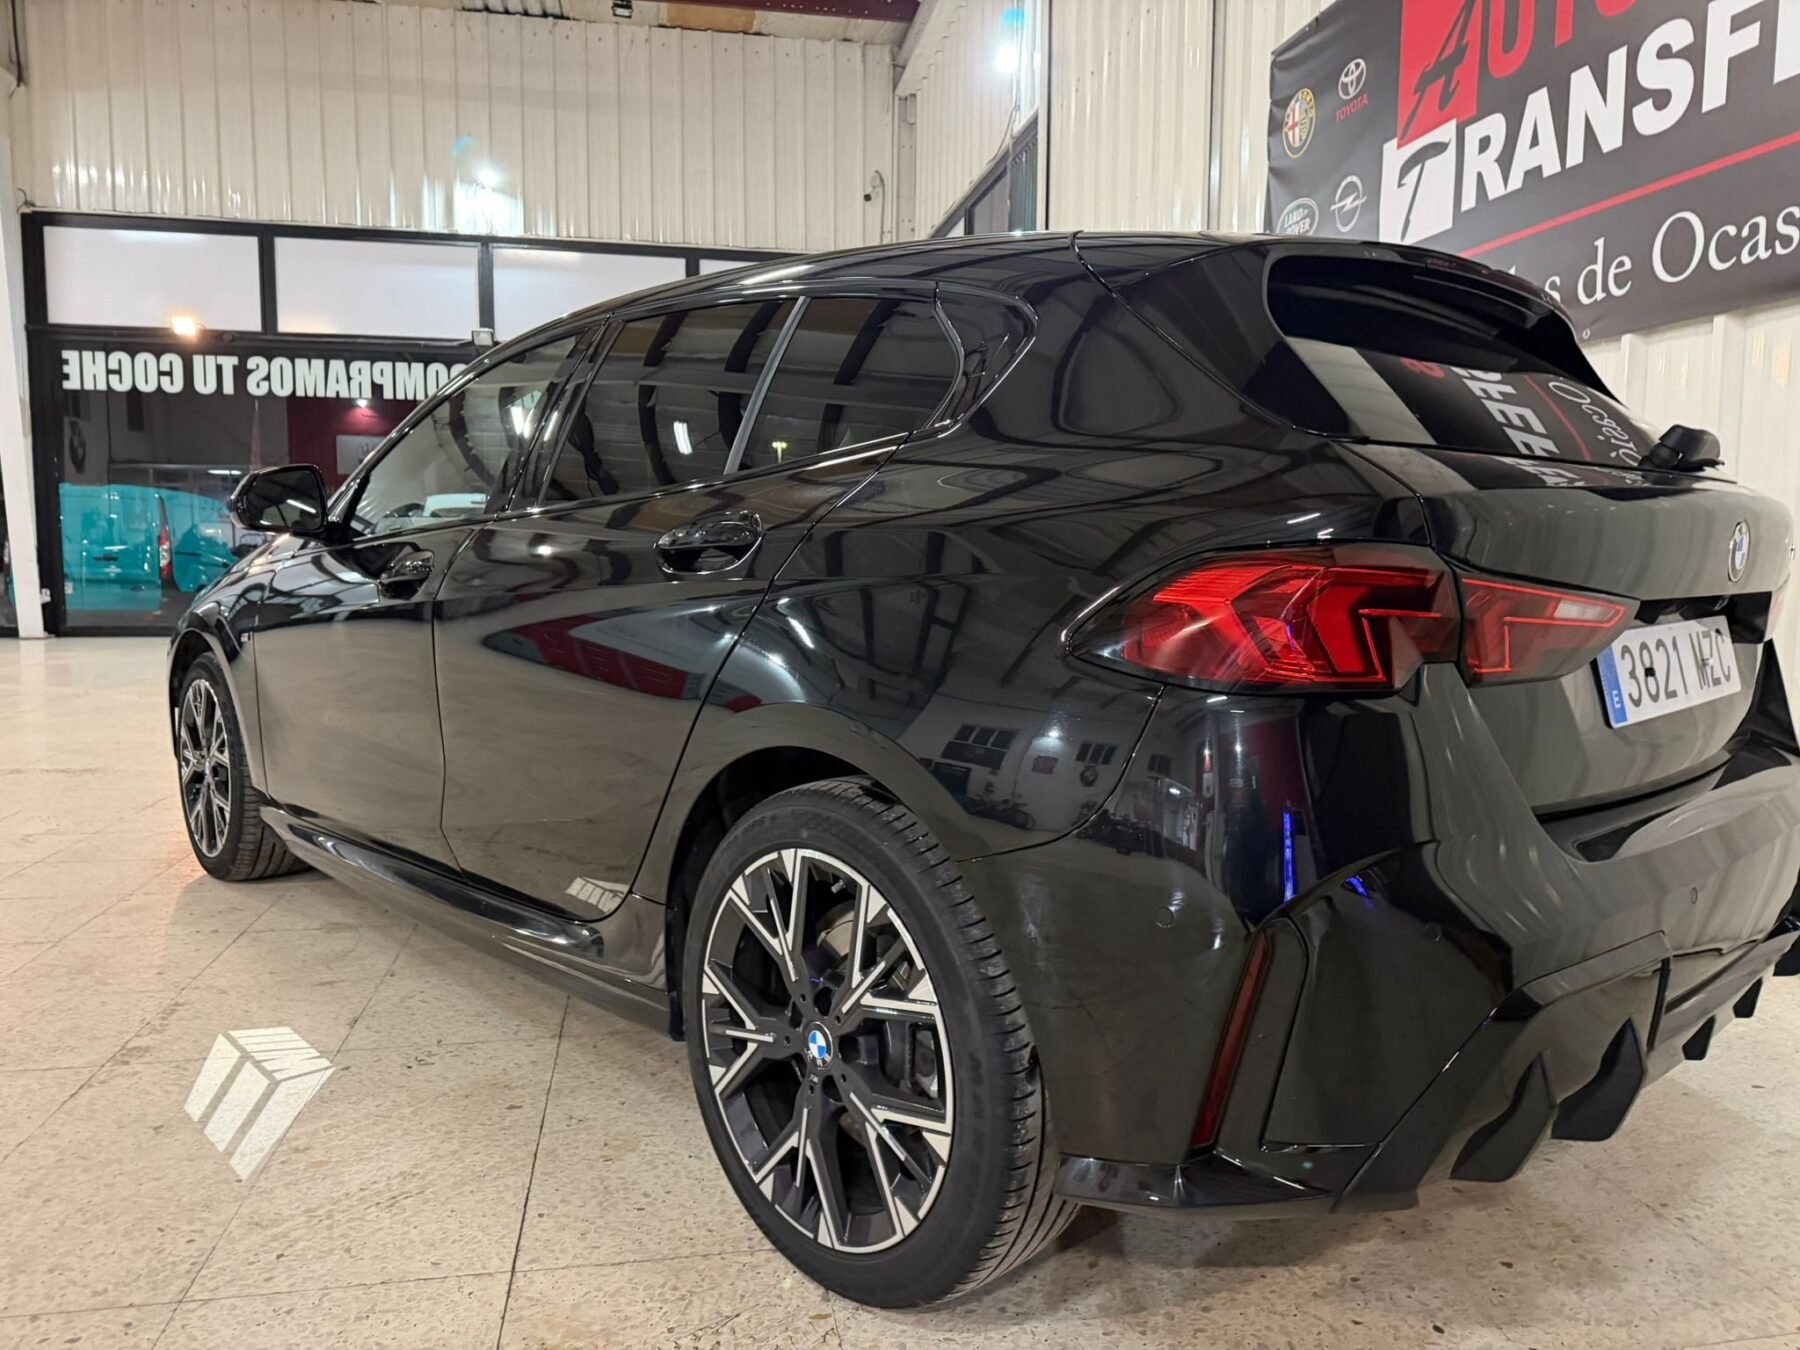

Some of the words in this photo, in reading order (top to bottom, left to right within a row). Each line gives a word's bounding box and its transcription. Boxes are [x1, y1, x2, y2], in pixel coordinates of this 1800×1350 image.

[1335, 94, 1369, 124] TOYOTA
[1284, 207, 1304, 229] LAND
[1577, 237, 1632, 305] de
[1652, 205, 1800, 283] Ocas
[1620, 635, 1689, 708] 3821
[1688, 627, 1731, 691] MZC
[1612, 690, 1621, 709] E
